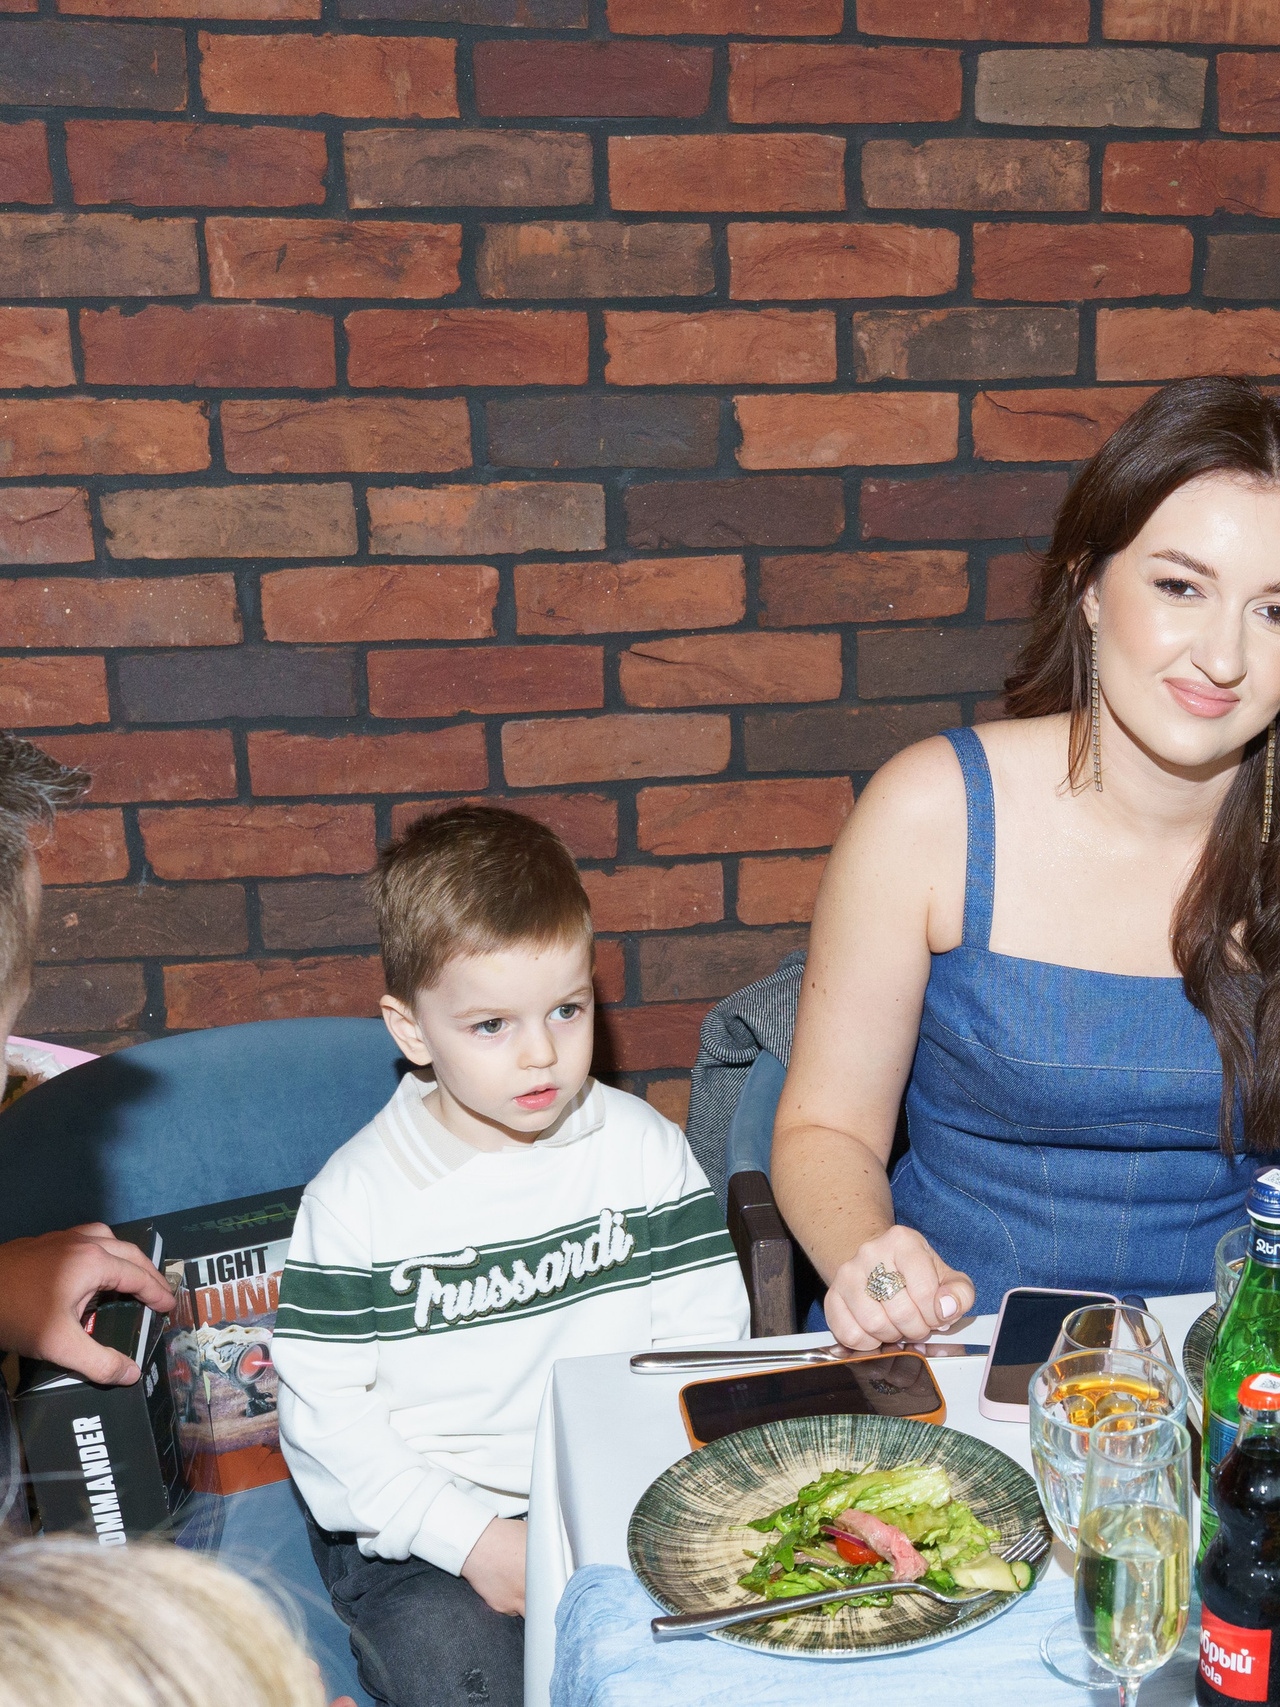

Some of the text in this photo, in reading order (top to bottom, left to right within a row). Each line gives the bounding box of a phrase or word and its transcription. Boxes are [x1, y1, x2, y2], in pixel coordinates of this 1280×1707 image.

[191, 1246, 268, 1288] LIGHT
[390, 1208, 636, 1332] Trussardi
[72, 1415, 128, 1549] OMMANDER
[1200, 1626, 1252, 1675] брый
[1201, 1659, 1223, 1686] cola
